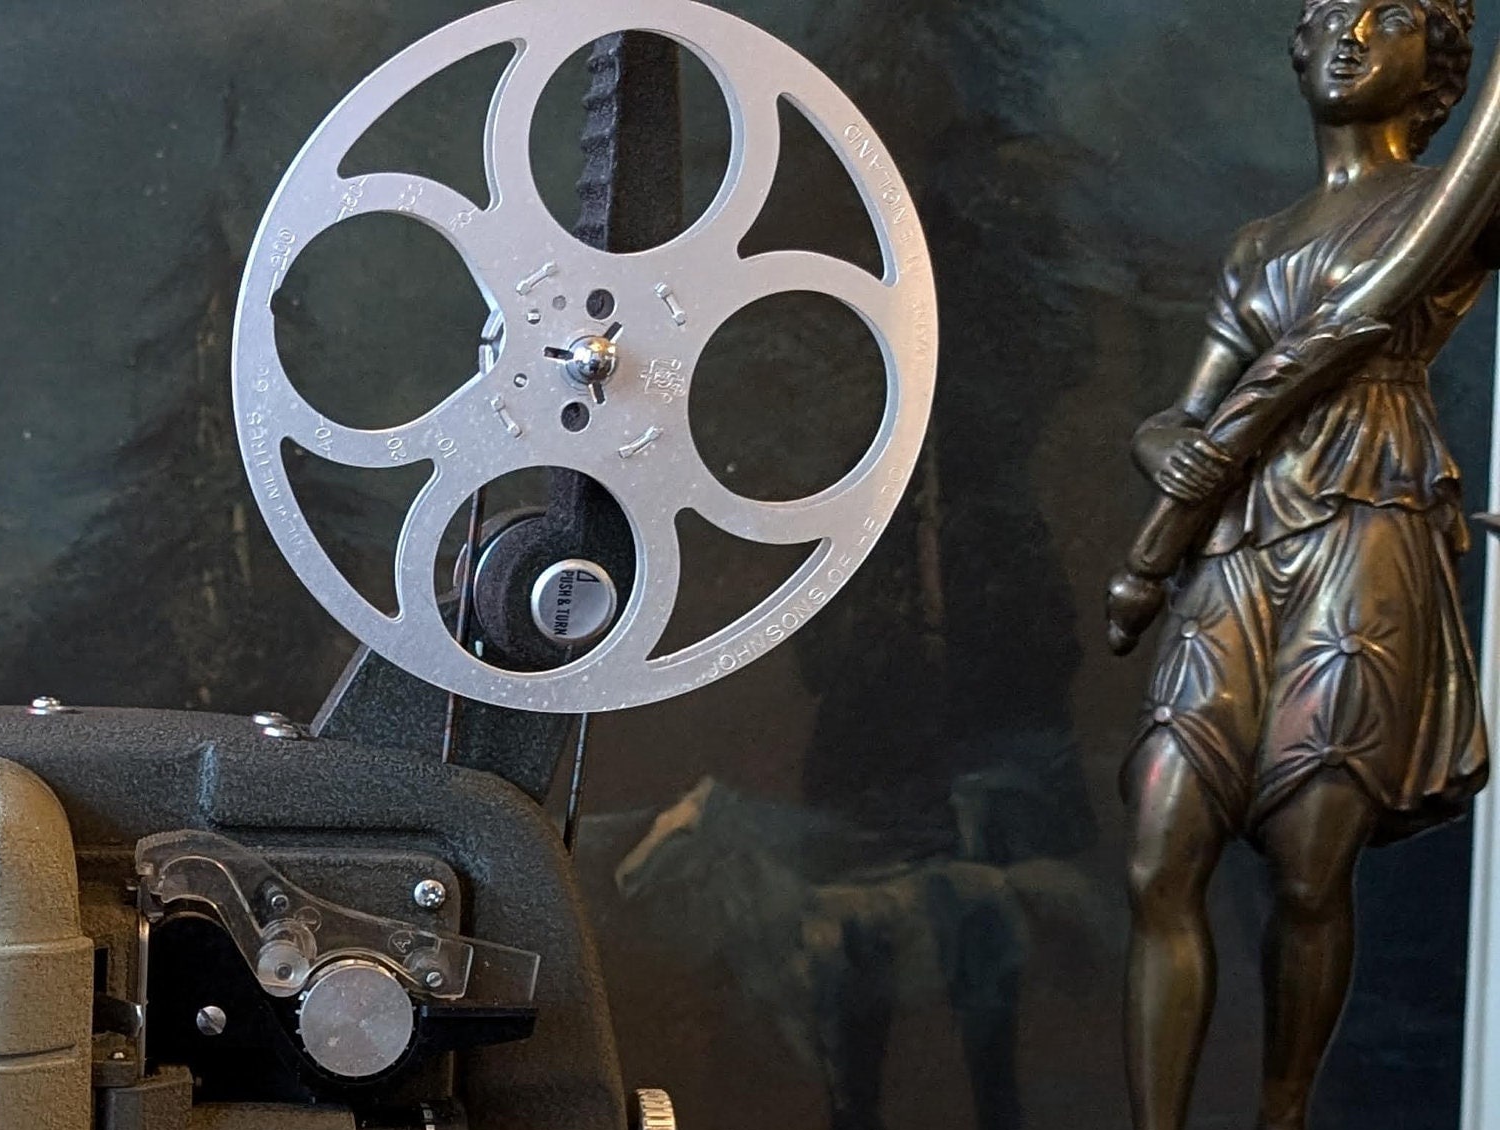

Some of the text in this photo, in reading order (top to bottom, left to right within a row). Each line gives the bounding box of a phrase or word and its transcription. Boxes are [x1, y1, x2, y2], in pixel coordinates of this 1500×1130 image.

[844, 123, 914, 243] ENGLAND
[558, 569, 575, 597] PUSH
[553, 608, 570, 636] TURN
[709, 586, 827, 678] JOHNSONS
